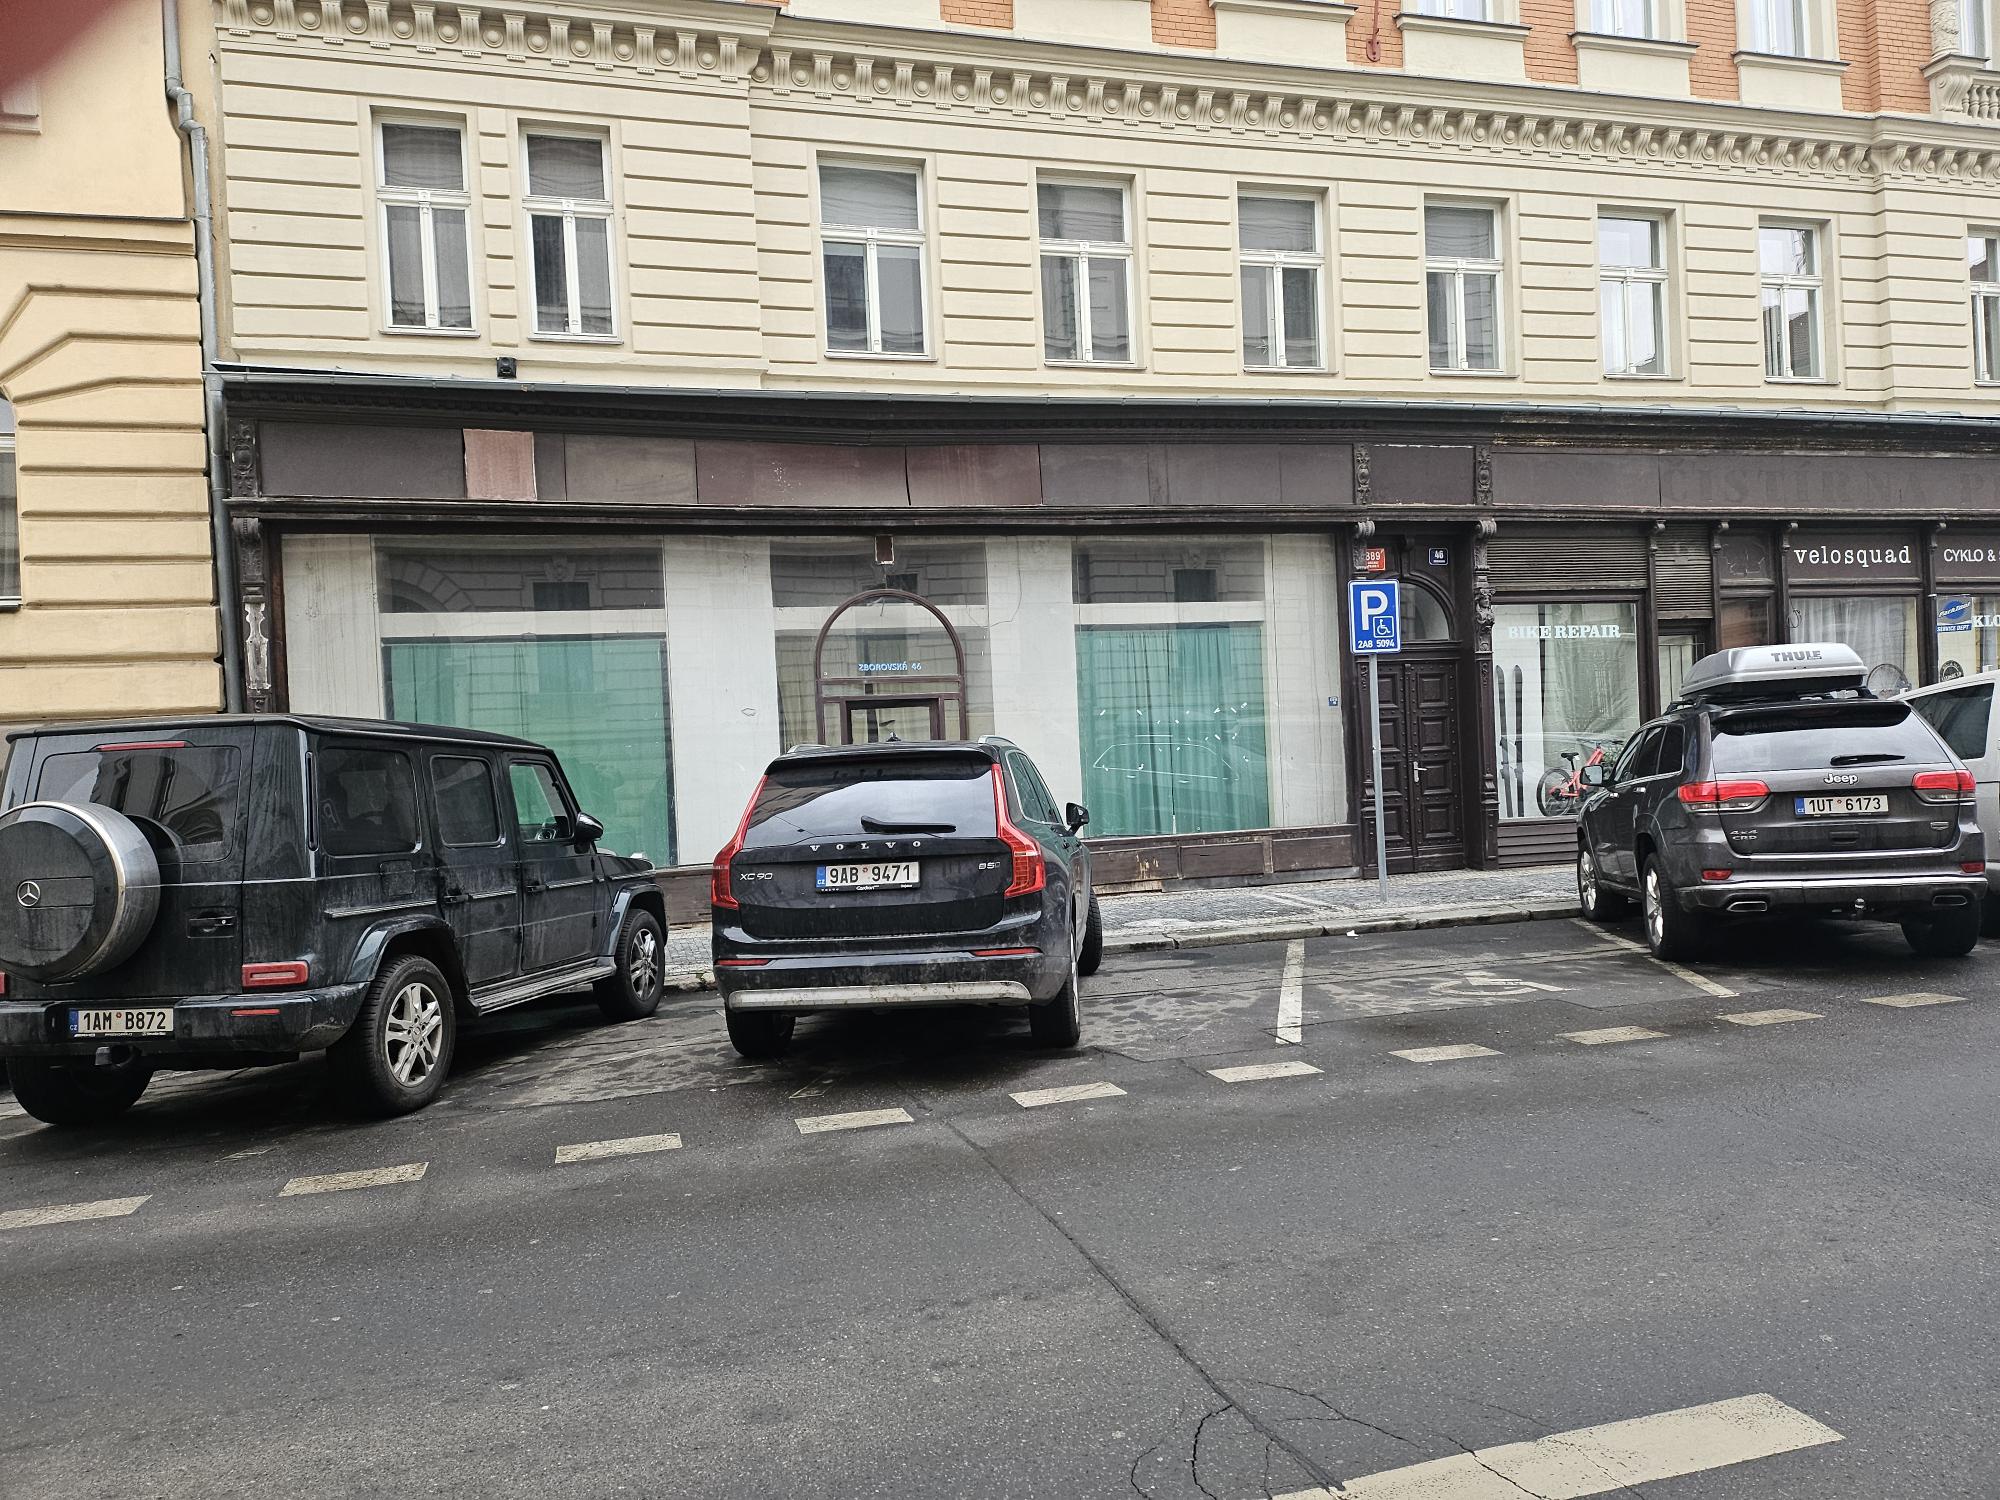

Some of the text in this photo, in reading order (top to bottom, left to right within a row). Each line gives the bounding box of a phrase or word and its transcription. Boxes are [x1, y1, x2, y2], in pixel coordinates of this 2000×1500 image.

[1434, 550, 1444, 559] 46
[1793, 545, 1912, 568] velosquad
[1943, 548, 1997, 562] CYKLO &
[1360, 590, 1388, 631] P
[1508, 624, 1621, 639] BIKE REPAIR
[1357, 639, 1395, 648] 2A8 5094
[1770, 650, 1823, 662] THULE
[858, 660, 922, 672] ZBOROVSKÁ 46
[1823, 773, 1859, 785] Jeep
[1808, 798, 1834, 813] 1UT
[1845, 797, 1881, 811] 6173
[809, 840, 921, 852] VOLVO
[739, 872, 773, 881] XC90
[829, 866, 859, 884] 9AB
[871, 864, 911, 882] 9471
[83, 1011, 112, 1031] 1AM
[125, 1011, 166, 1030] B872
